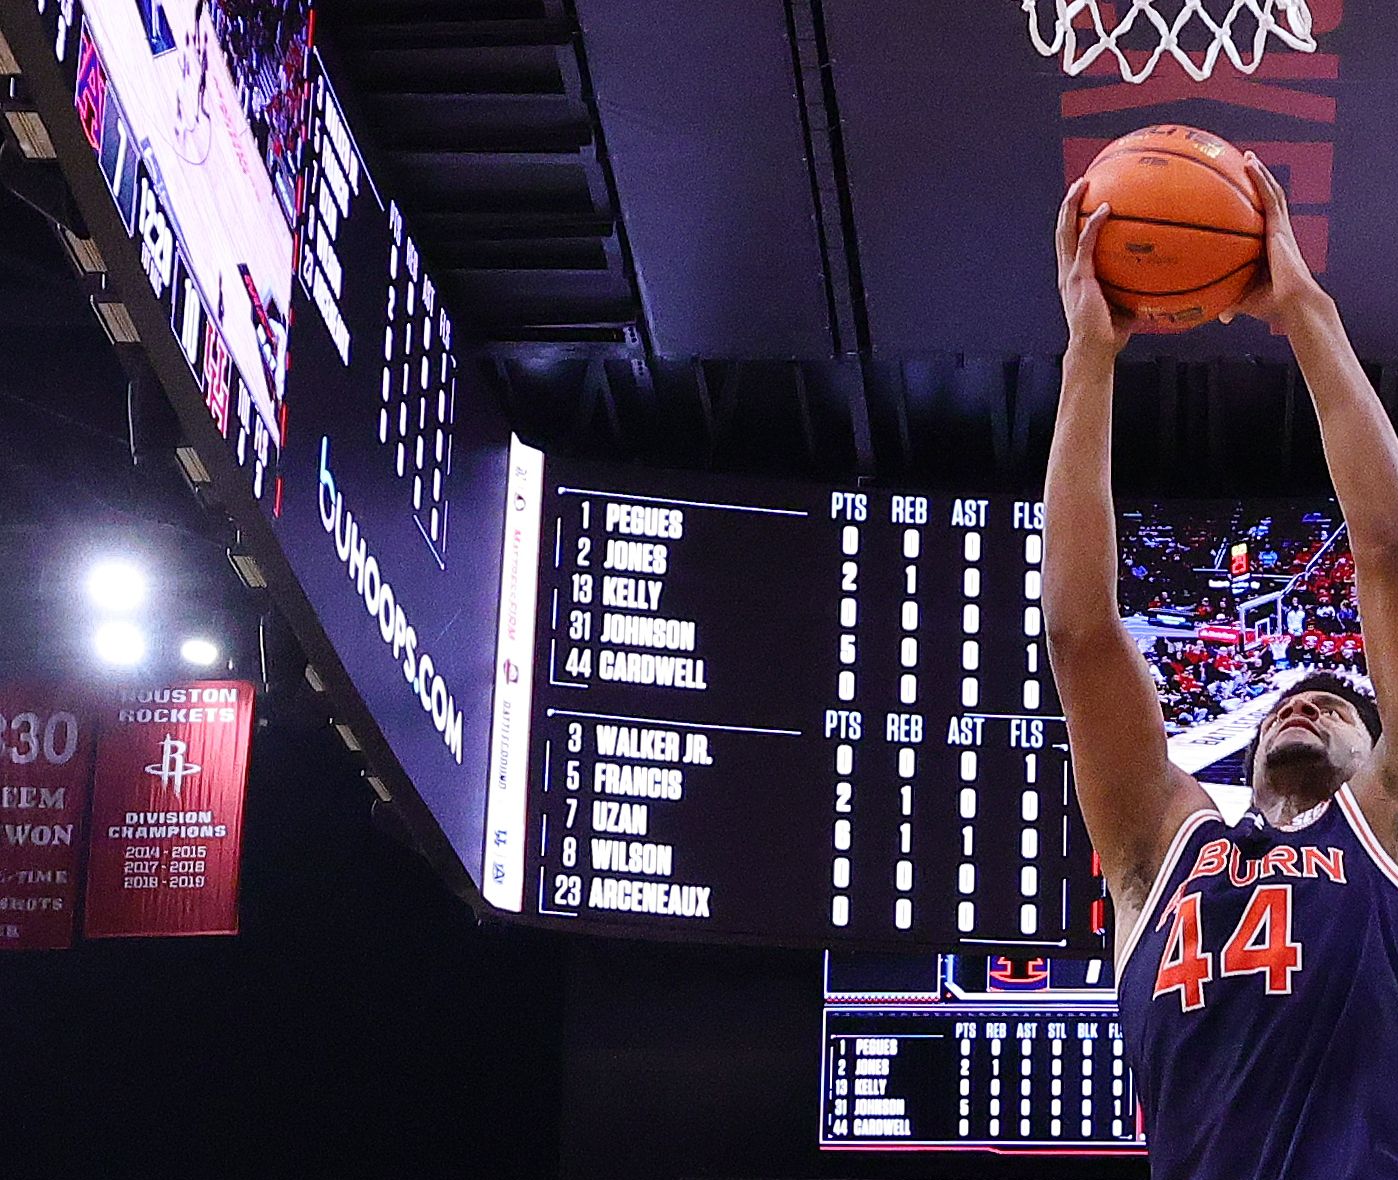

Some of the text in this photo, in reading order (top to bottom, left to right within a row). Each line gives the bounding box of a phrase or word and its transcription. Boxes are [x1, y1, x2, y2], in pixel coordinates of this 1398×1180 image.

[581, 501, 919, 558] 1 PEGUES 0 0
[832, 492, 1045, 530] PTS REB AST FLS
[577, 537, 916, 594] 2 JONES 2 1
[572, 573, 917, 630] 13 KELLY 0 0
[570, 610, 917, 667] 31 JOHNSON 5 0
[566, 648, 916, 703] 44 CARDWELL 0 0
[119, 707, 236, 723] ROCKETS
[122, 688, 238, 704] OUSTON
[826, 710, 1044, 749] PTS REB AST FLS
[568, 723, 914, 777] 3 WALKER JR. 0 0
[567, 761, 911, 815] 5 FRANCIS 2 1
[108, 825, 227, 839] CHAMPIONS
[126, 811, 213, 825] DIVISION
[567, 799, 910, 852] 7 UZAN 6 1
[124, 861, 160, 874] 2017
[125, 846, 160, 859] 2014
[563, 837, 912, 890] 8 WILSON 0 0
[555, 875, 911, 929] 23 ARCENEAUX 0 0
[1153, 884, 1302, 1013] 44
[955, 1022, 1123, 1039] PTS REB AST STL BLK FL
[837, 1058, 846, 1076] 2
[855, 1078, 888, 1096] KELLY
[833, 1118, 848, 1136] 44
